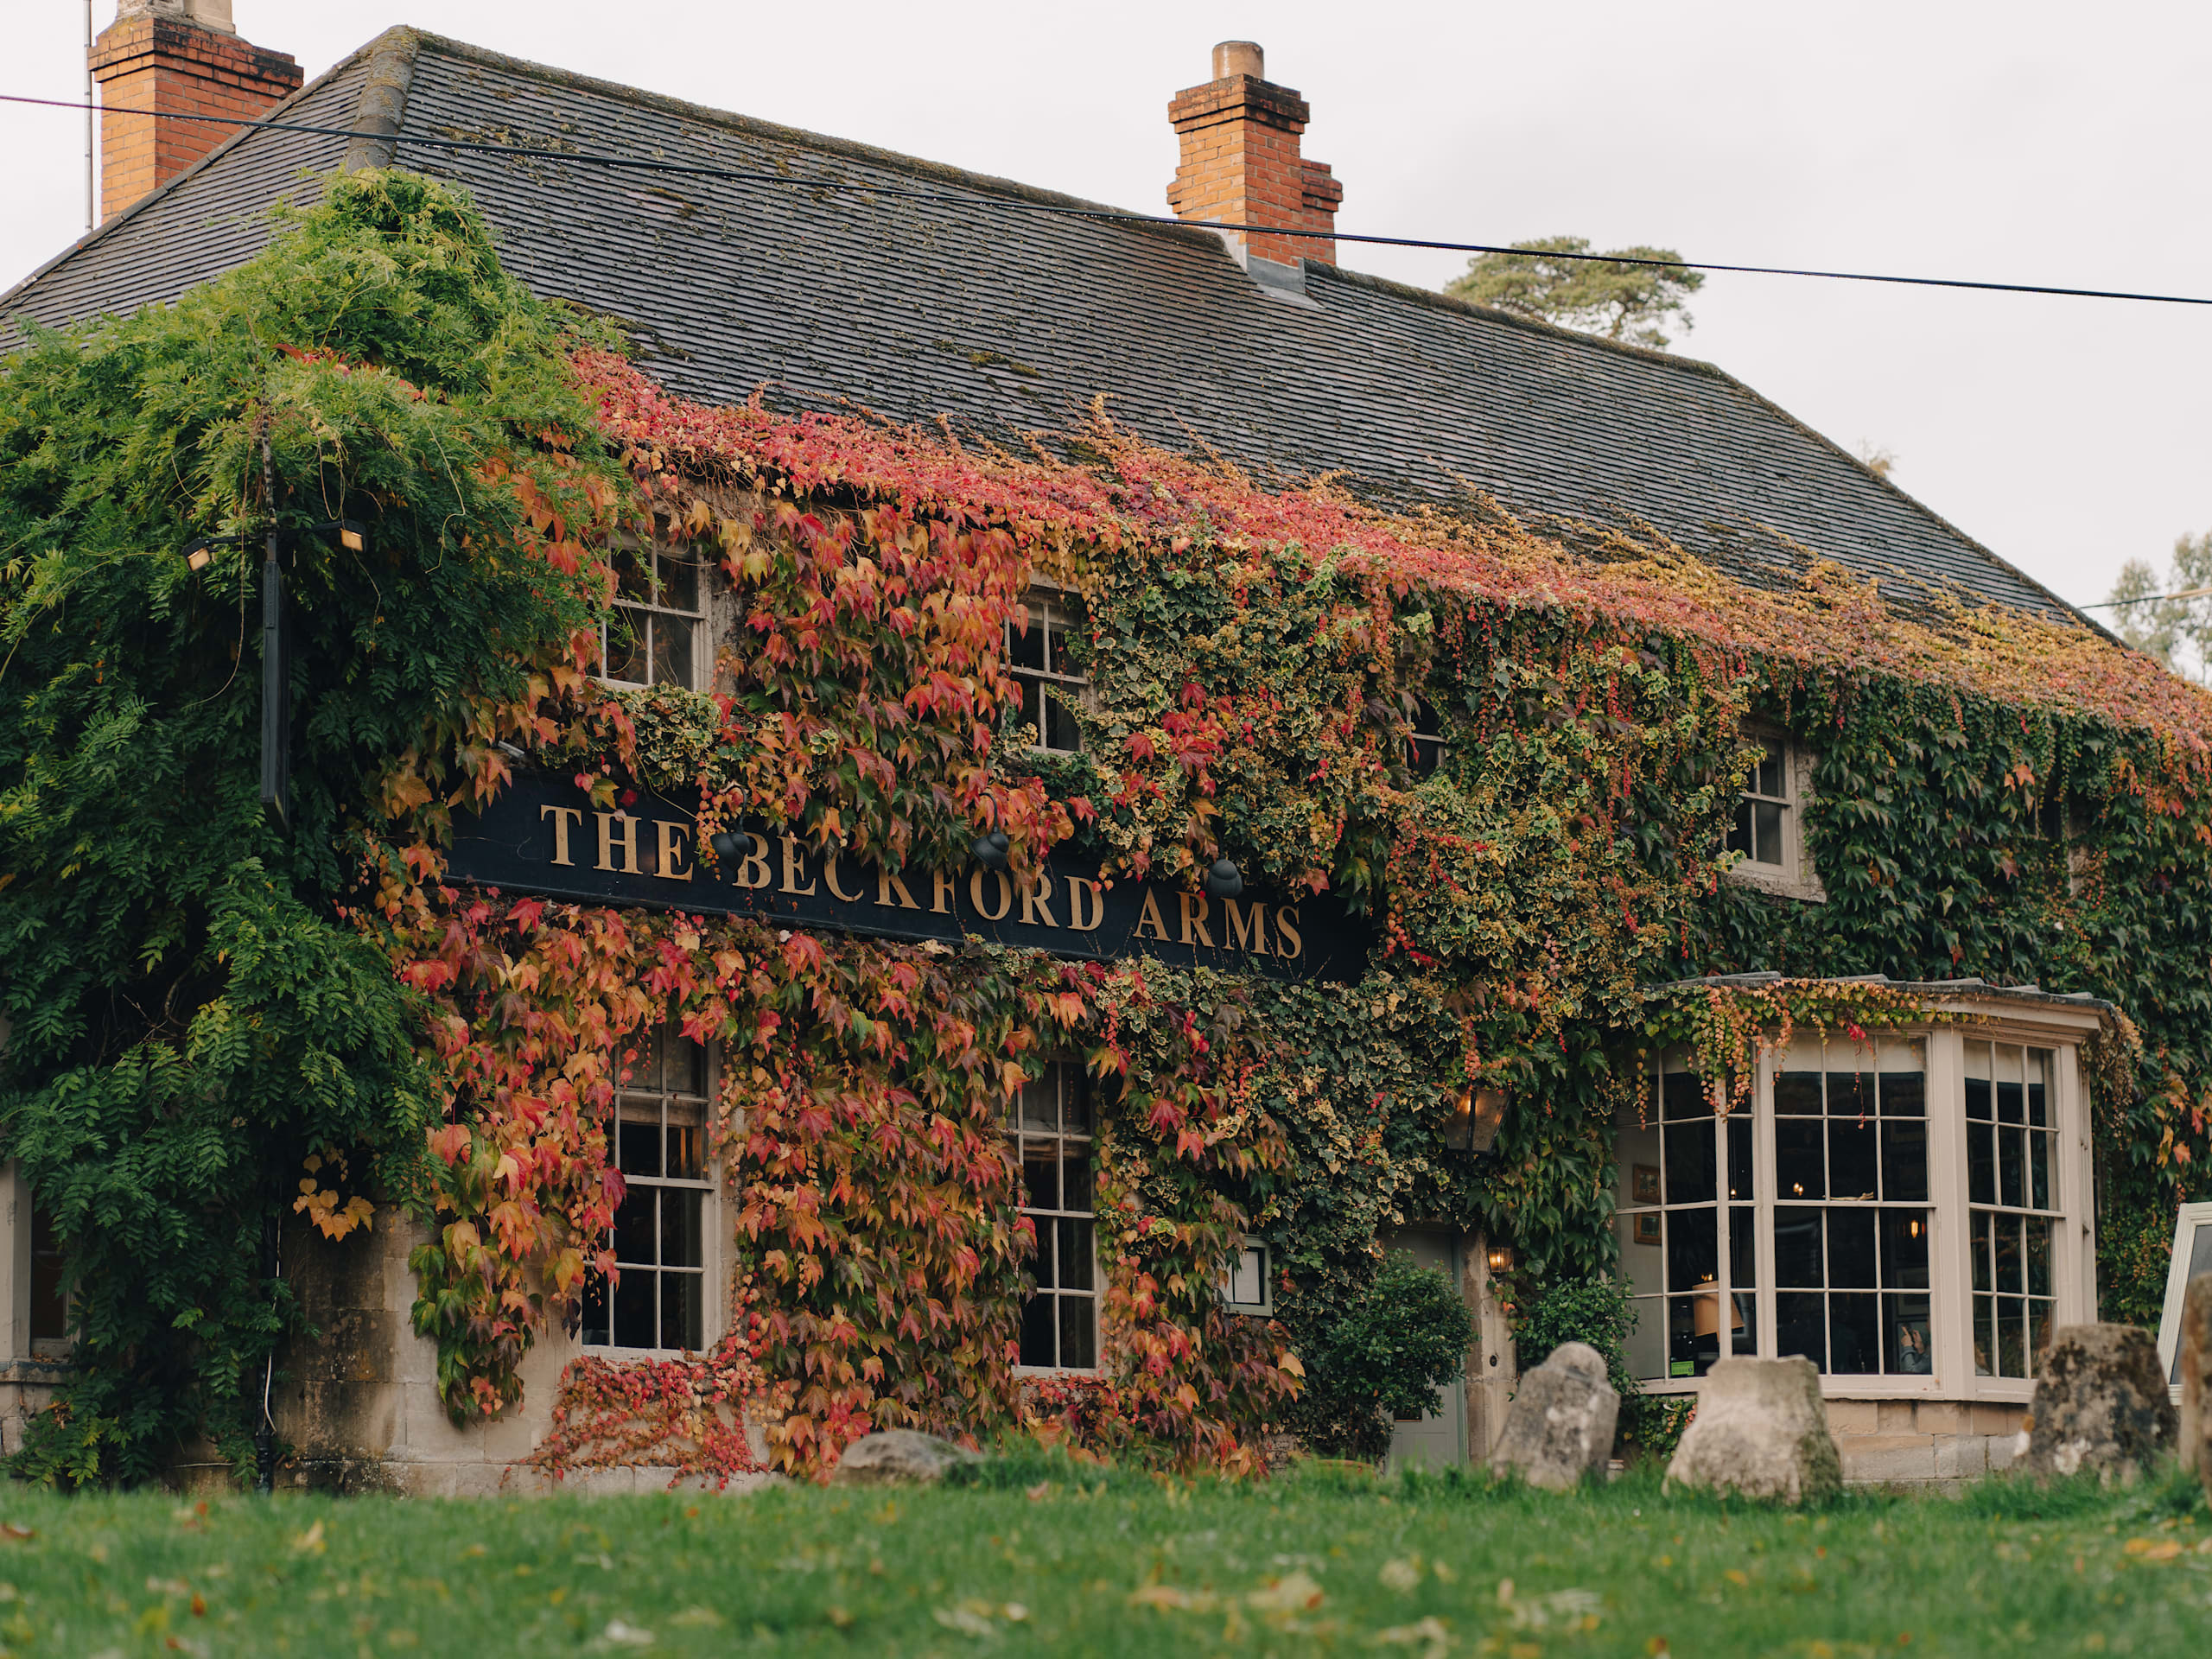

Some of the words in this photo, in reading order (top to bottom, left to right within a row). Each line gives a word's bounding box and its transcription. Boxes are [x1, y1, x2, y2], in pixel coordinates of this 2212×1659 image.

[540, 804, 694, 880] THE
[732, 831, 1104, 931] BECKFORD
[1133, 886, 1302, 959] ARMS
